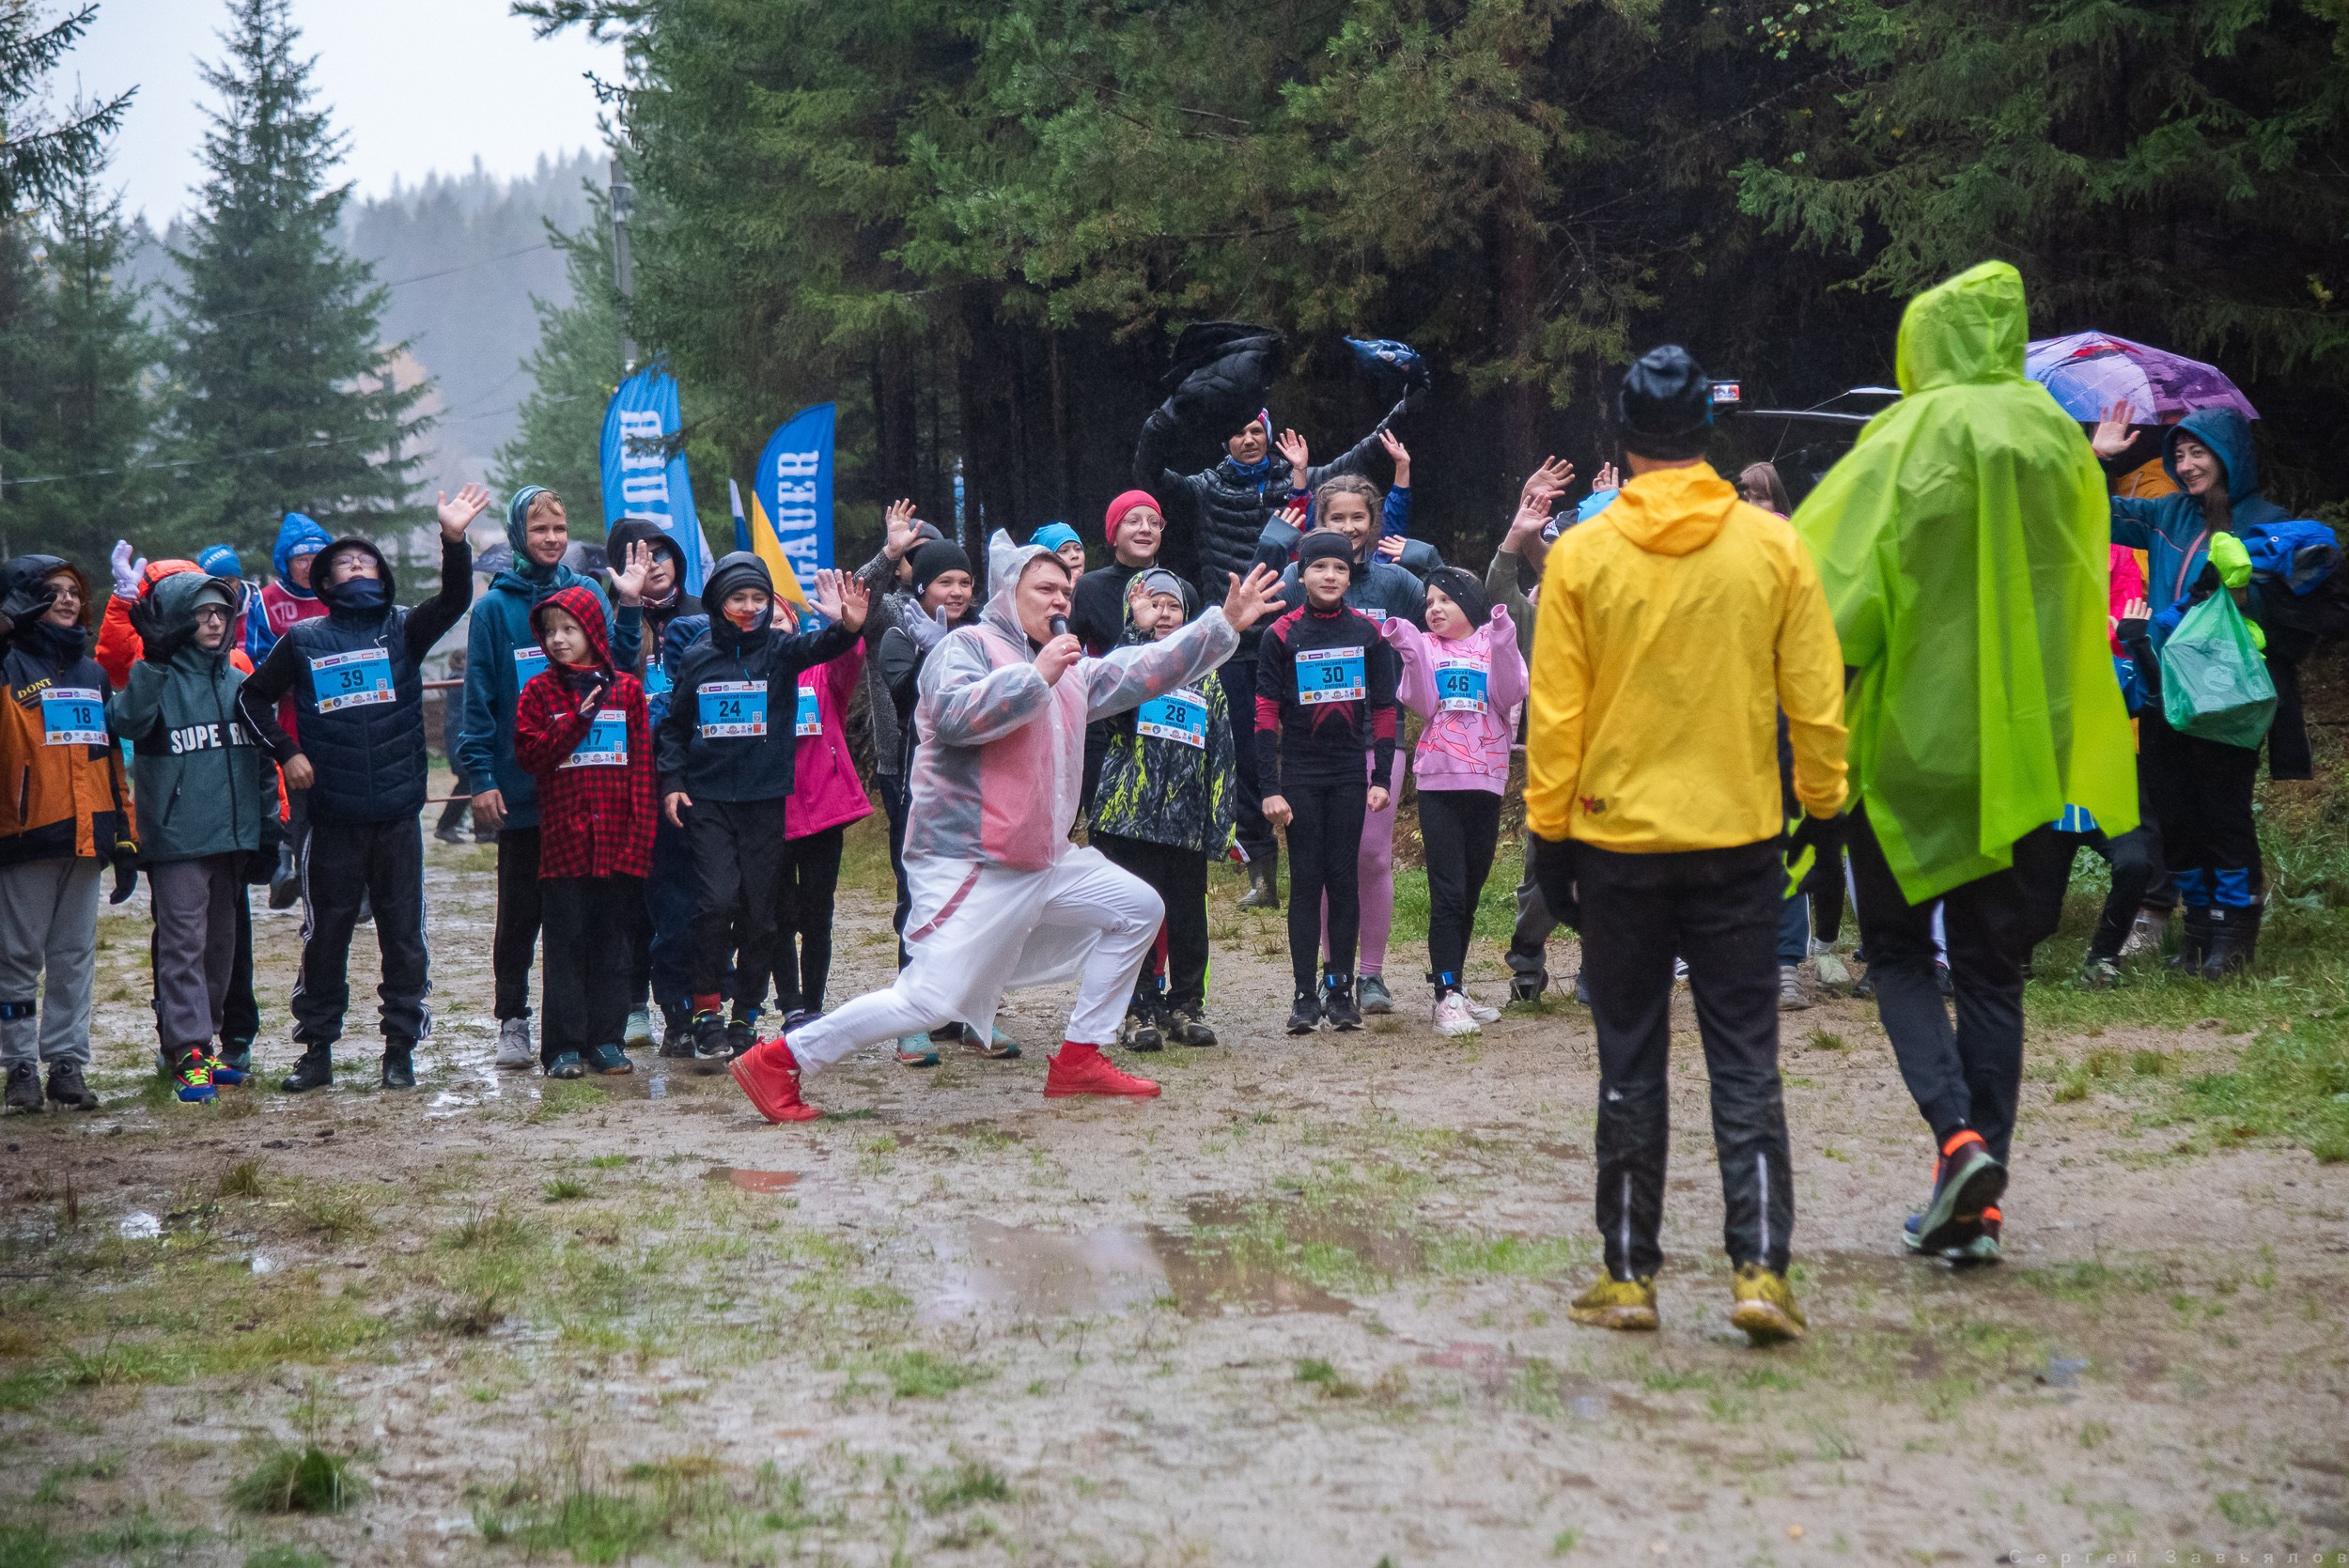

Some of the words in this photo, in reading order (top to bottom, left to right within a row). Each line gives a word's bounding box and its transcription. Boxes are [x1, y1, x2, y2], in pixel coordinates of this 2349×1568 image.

[339, 669, 365, 689] 39
[1322, 666, 1345, 684] 30
[1447, 675, 1470, 692] 46
[17, 678, 53, 699] DONT
[72, 706, 92, 724] 18
[719, 700, 742, 718] 24
[1165, 704, 1187, 723] 28
